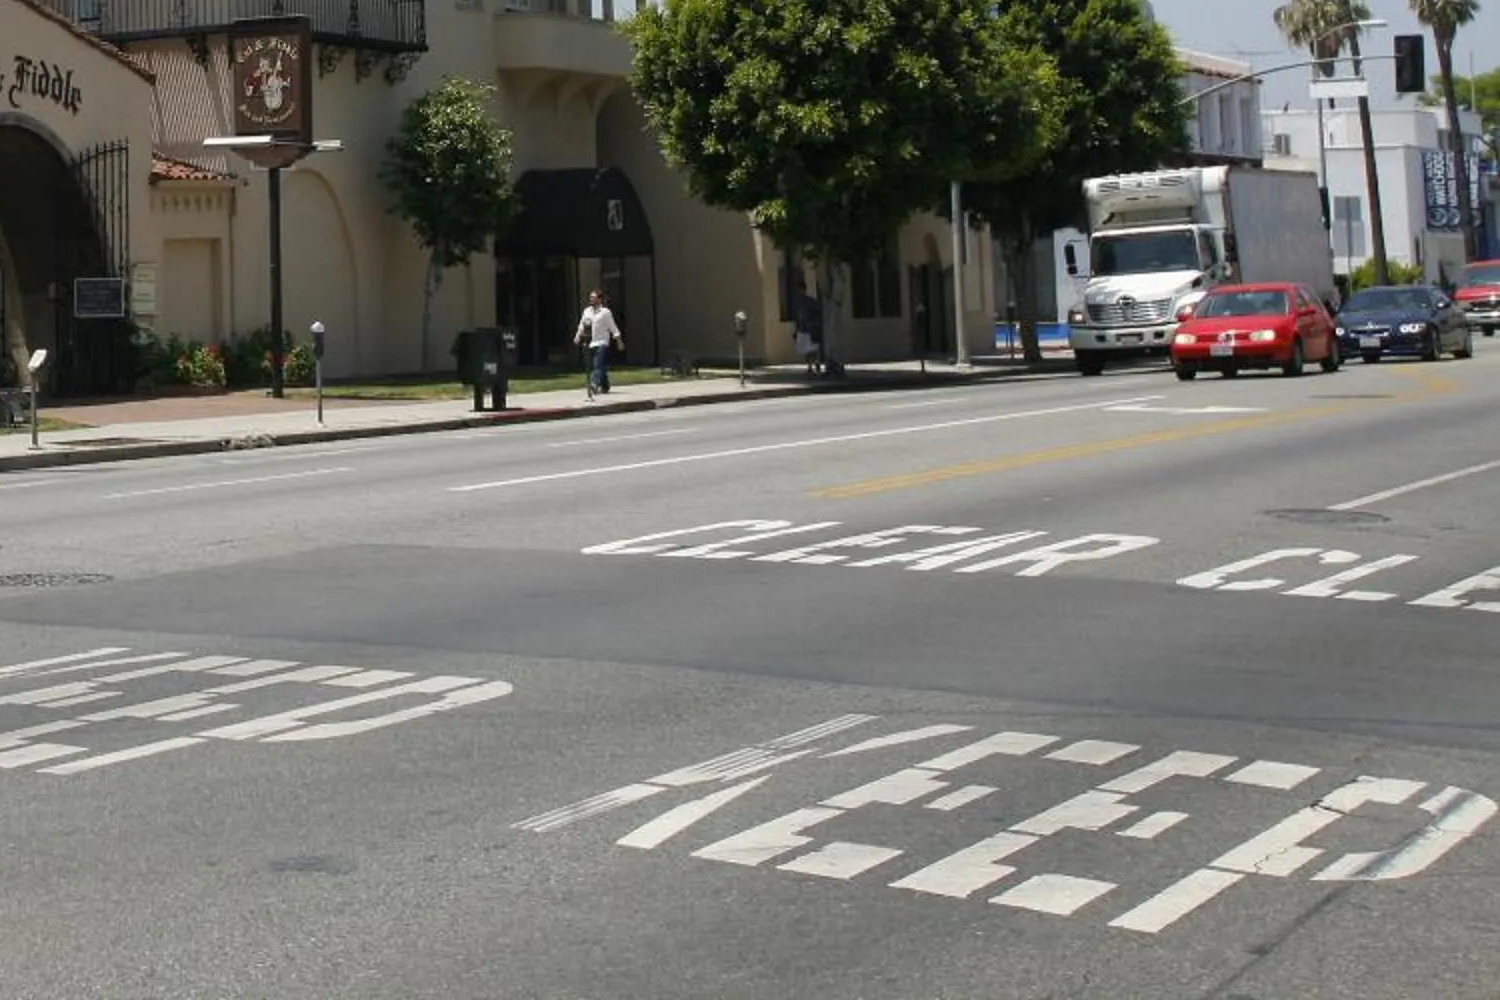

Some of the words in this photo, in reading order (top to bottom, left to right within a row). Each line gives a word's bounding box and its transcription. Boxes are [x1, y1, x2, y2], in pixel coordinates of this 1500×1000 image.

[8, 54, 82, 116] Fiddle
[581, 519, 1160, 577] CLEAR
[508, 713, 1498, 934] KEEP
